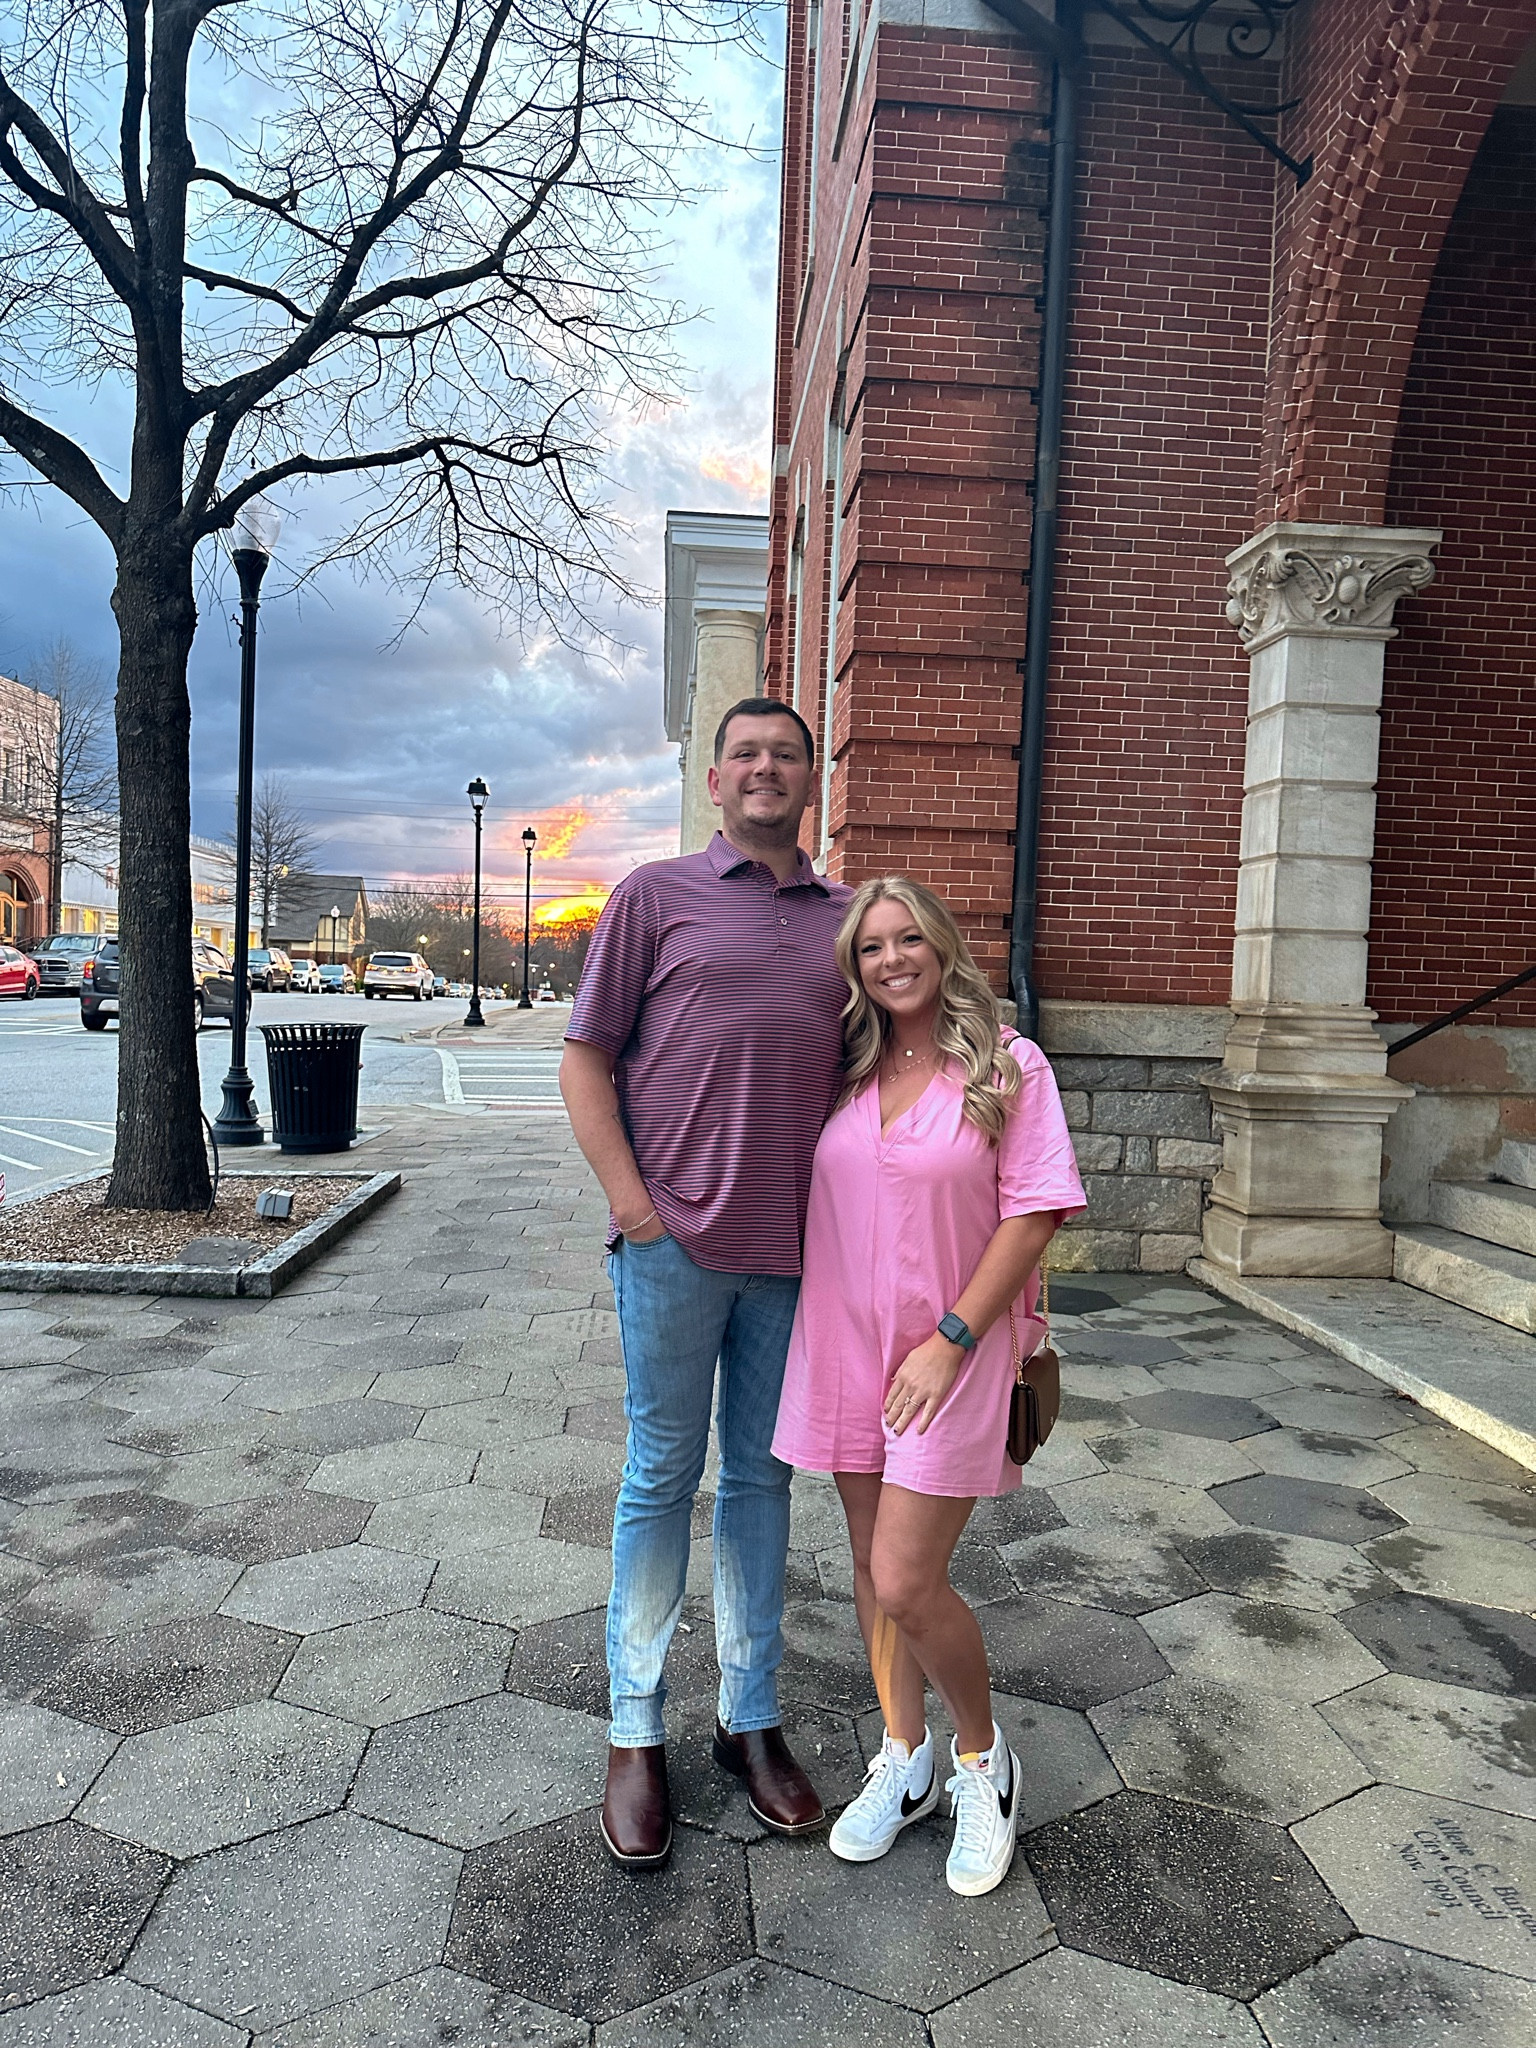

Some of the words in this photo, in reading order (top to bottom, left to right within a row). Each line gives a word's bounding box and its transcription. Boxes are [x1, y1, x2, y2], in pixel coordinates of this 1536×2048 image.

[1391, 1843, 1426, 1871] Nov.
[1414, 1830, 1445, 1855] City
[1443, 1865, 1509, 1920] Council
[1429, 1816, 1475, 1857] Allene
[1473, 1863, 1499, 1878] C.
